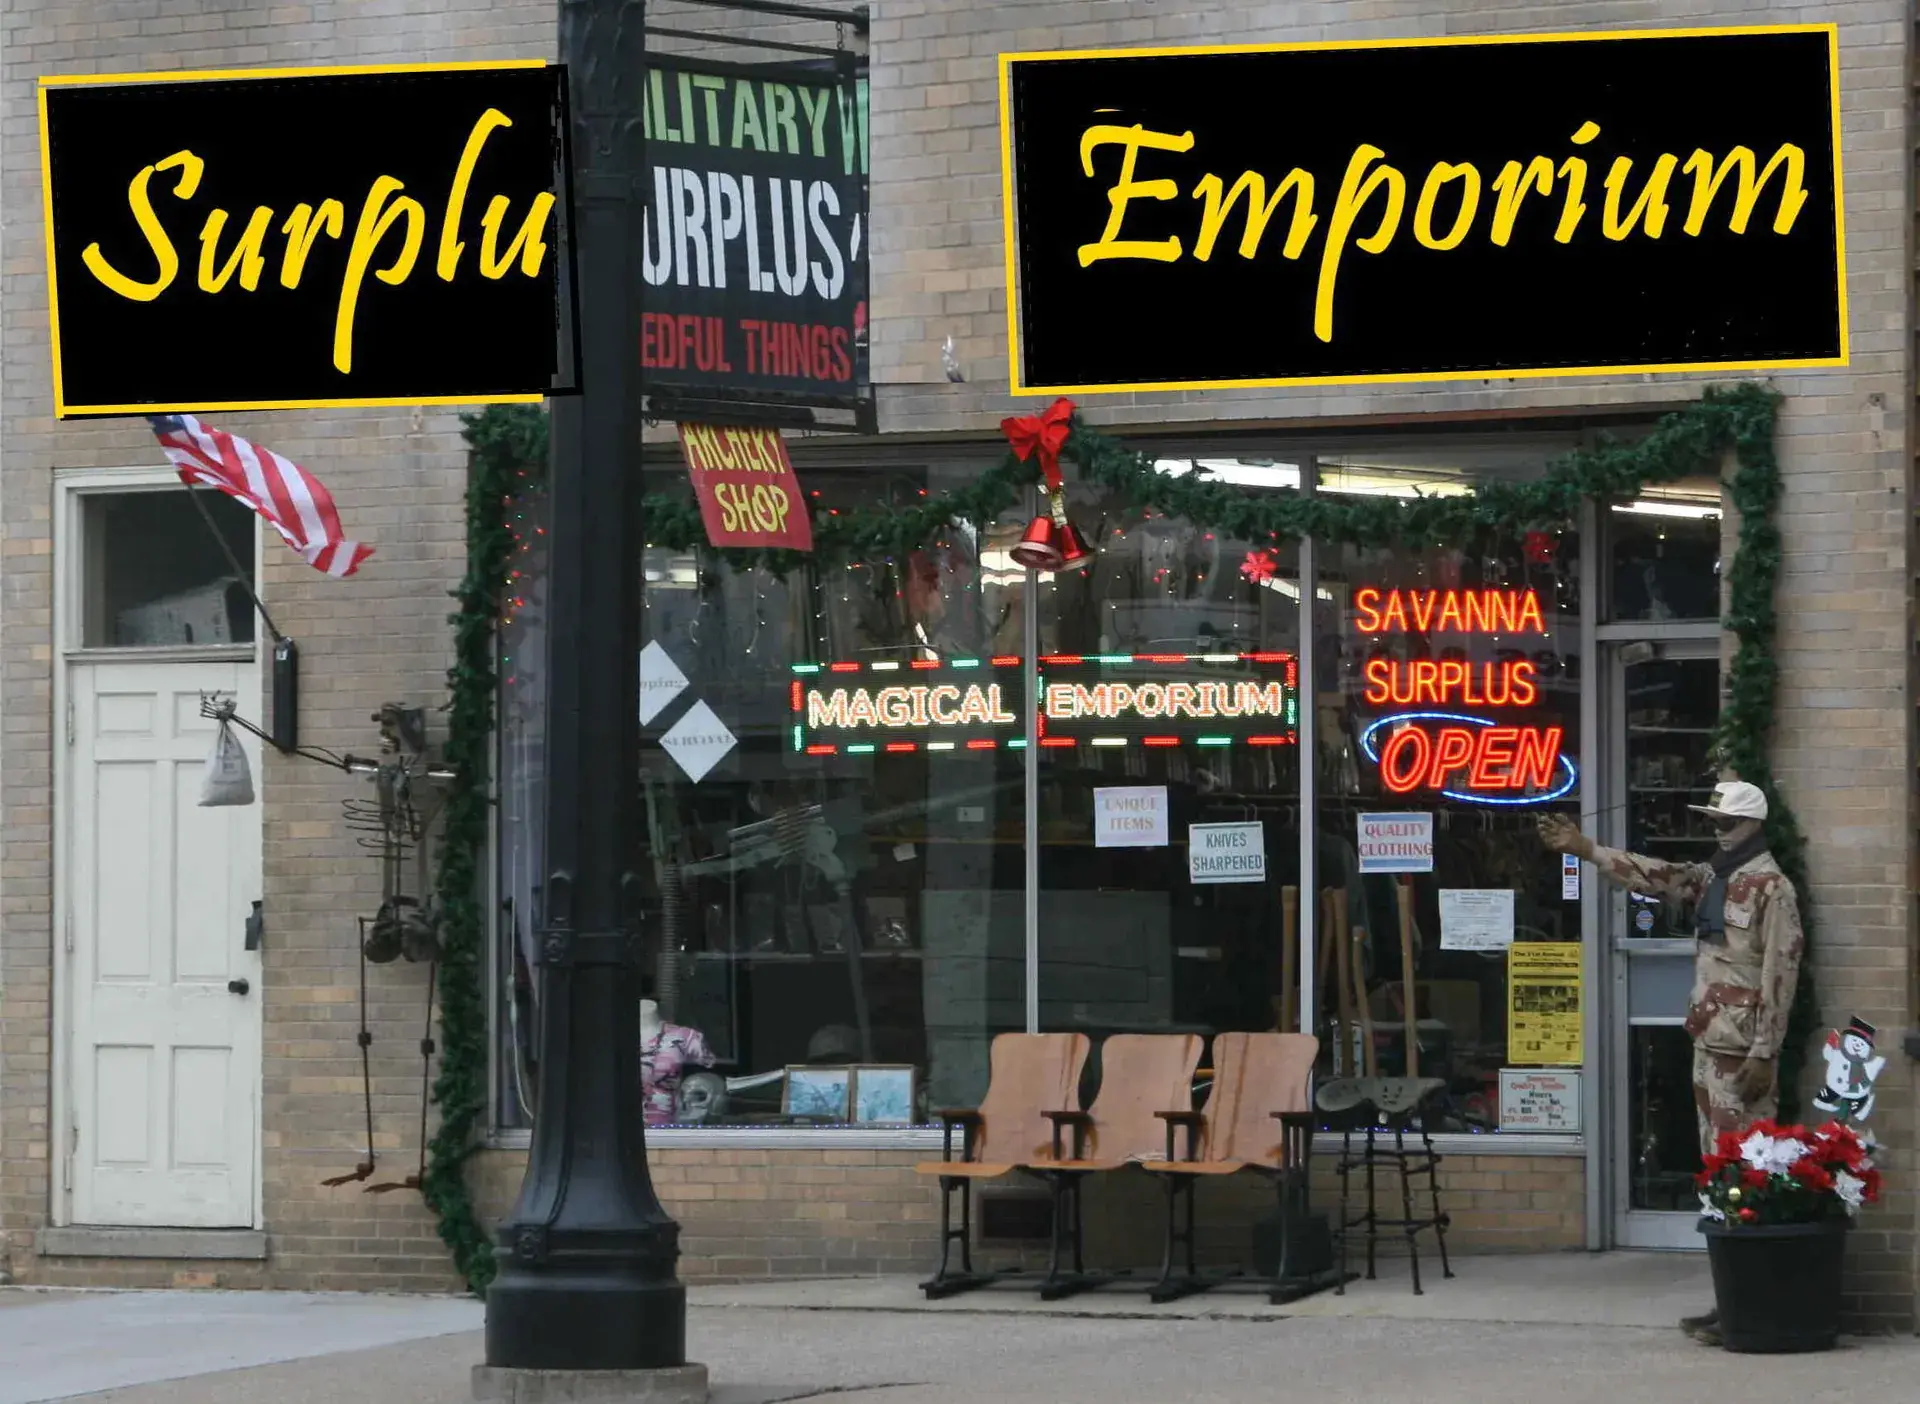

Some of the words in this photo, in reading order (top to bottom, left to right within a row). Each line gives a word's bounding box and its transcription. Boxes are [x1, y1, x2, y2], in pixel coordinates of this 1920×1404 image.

[81, 107, 556, 374] Surplu
[642, 166, 844, 300] URPLUS
[1077, 121, 1809, 343] Emporium
[641, 312, 732, 373] EDFUL
[739, 319, 851, 382] THINGS
[714, 482, 789, 533] SHOP
[1355, 588, 1544, 634] SAVANNA
[807, 683, 1017, 729] MAGICAL
[1046, 681, 1282, 718] EMPORIUM
[1364, 660, 1537, 706] SURPLUS
[1380, 725, 1564, 794] OPEN
[1104, 797, 1158, 811] UNIQUE
[1110, 817, 1154, 831] ITEMS
[1206, 831, 1248, 848] KNIVES
[1359, 842, 1433, 857] CLOTHING
[1364, 823, 1427, 838] QUALITY
[1192, 855, 1263, 872] SHARPENED
